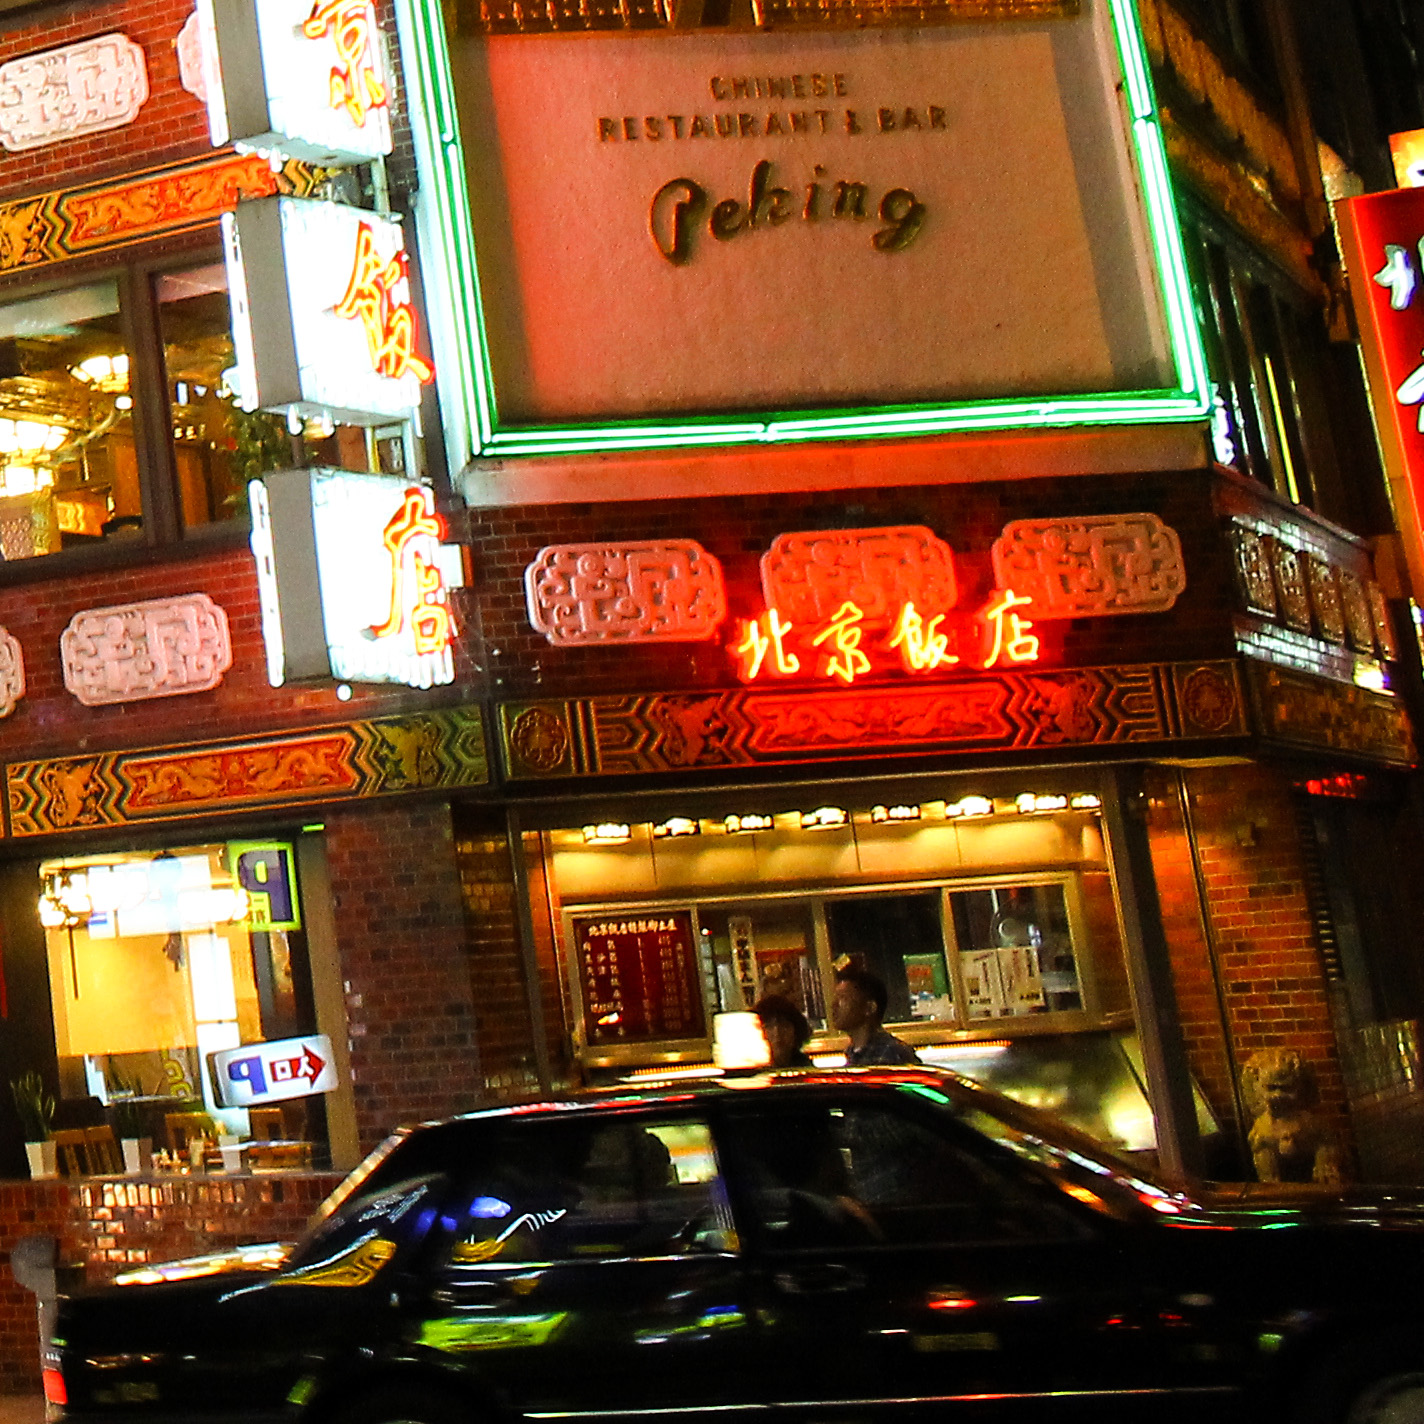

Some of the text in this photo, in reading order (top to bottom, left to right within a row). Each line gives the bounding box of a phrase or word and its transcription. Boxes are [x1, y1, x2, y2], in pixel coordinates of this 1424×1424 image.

[709, 73, 848, 102] CHINESE
[597, 105, 950, 143] RESTAURANT & BAR
[649, 159, 926, 267] Peking
[736, 589, 1041, 683] 北京飯店
